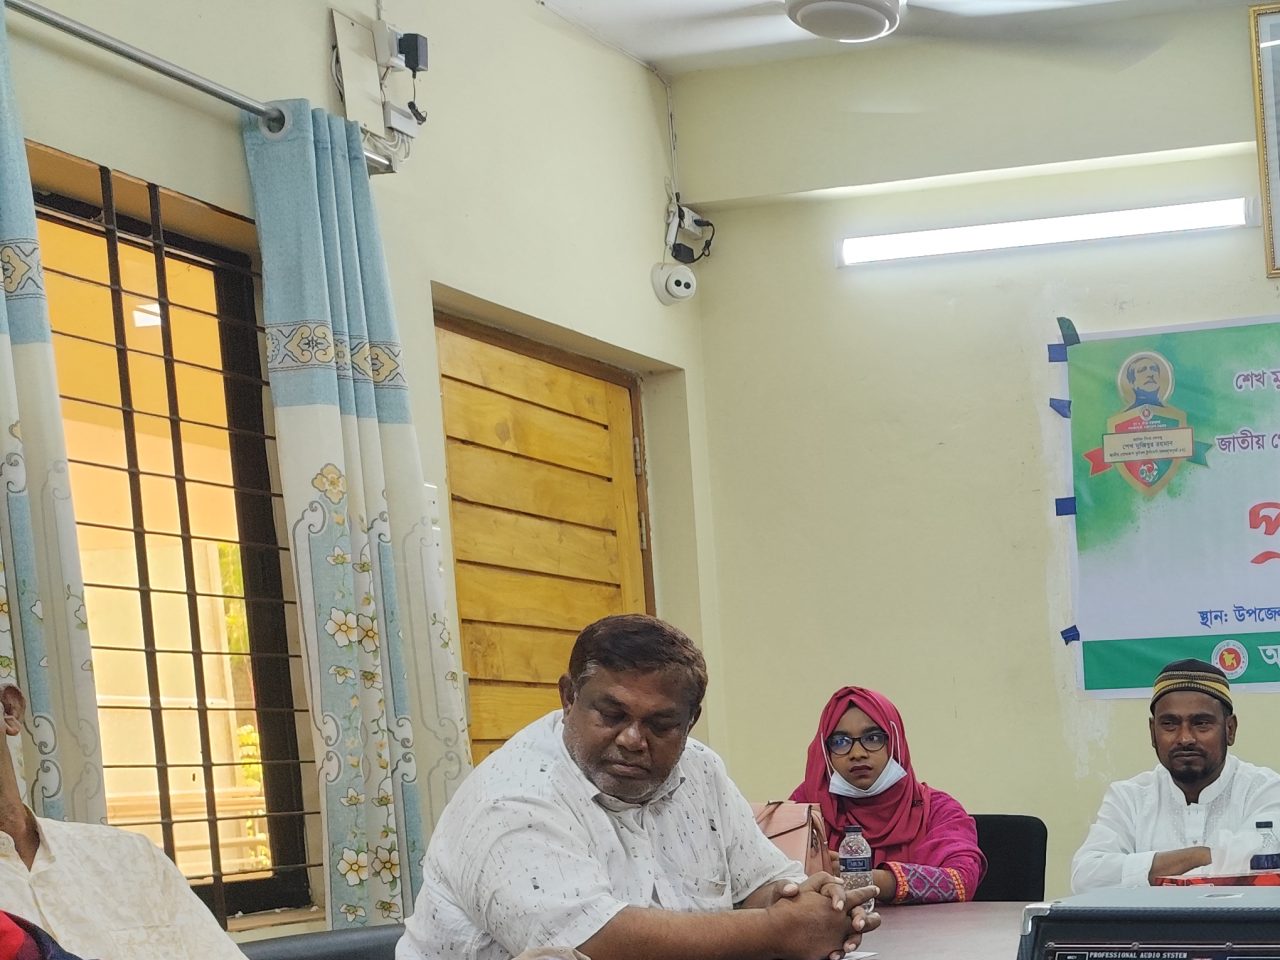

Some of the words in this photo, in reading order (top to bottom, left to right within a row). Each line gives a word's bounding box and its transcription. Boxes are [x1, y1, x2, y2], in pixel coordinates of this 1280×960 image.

[1234, 368, 1265, 391] শেখ
[1216, 430, 1266, 454] জাতীয়
[1089, 951, 1138, 959] PROFESSIONAL
[1140, 951, 1161, 959] AUDIO
[1162, 951, 1188, 959] SYSTEM
